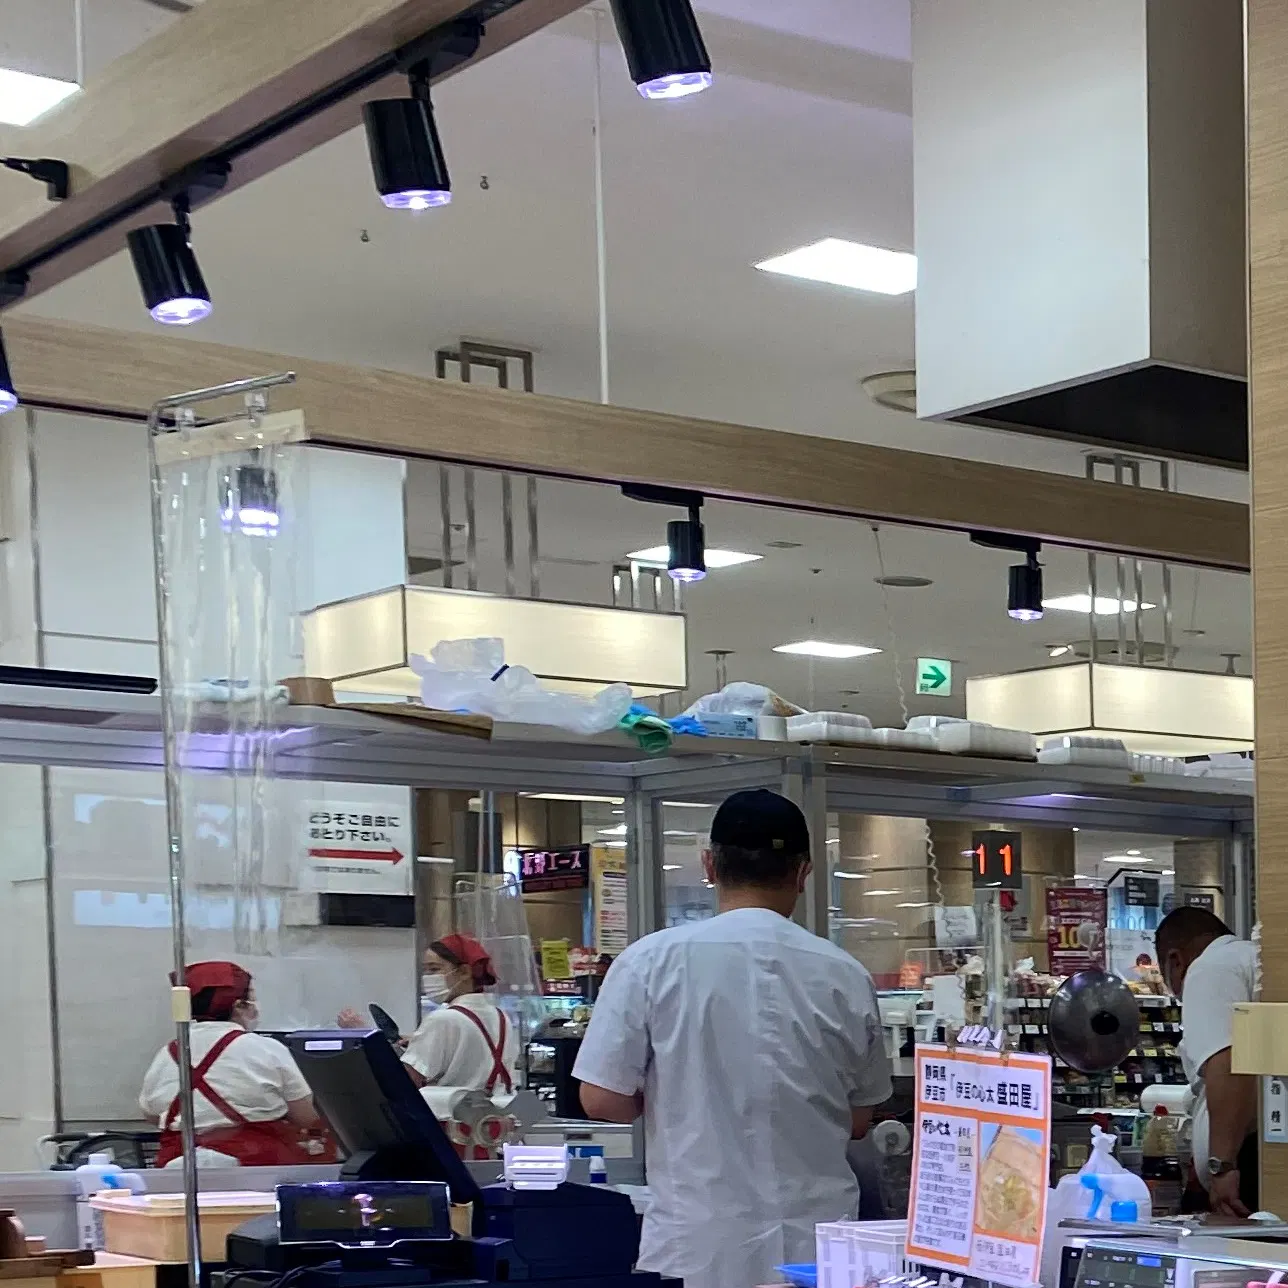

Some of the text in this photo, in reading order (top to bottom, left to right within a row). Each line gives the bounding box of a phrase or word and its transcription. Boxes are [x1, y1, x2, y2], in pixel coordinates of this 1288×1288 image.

[309, 811, 400, 828] どうぞご自由に
[310, 828, 392, 842] おとり下さい。
